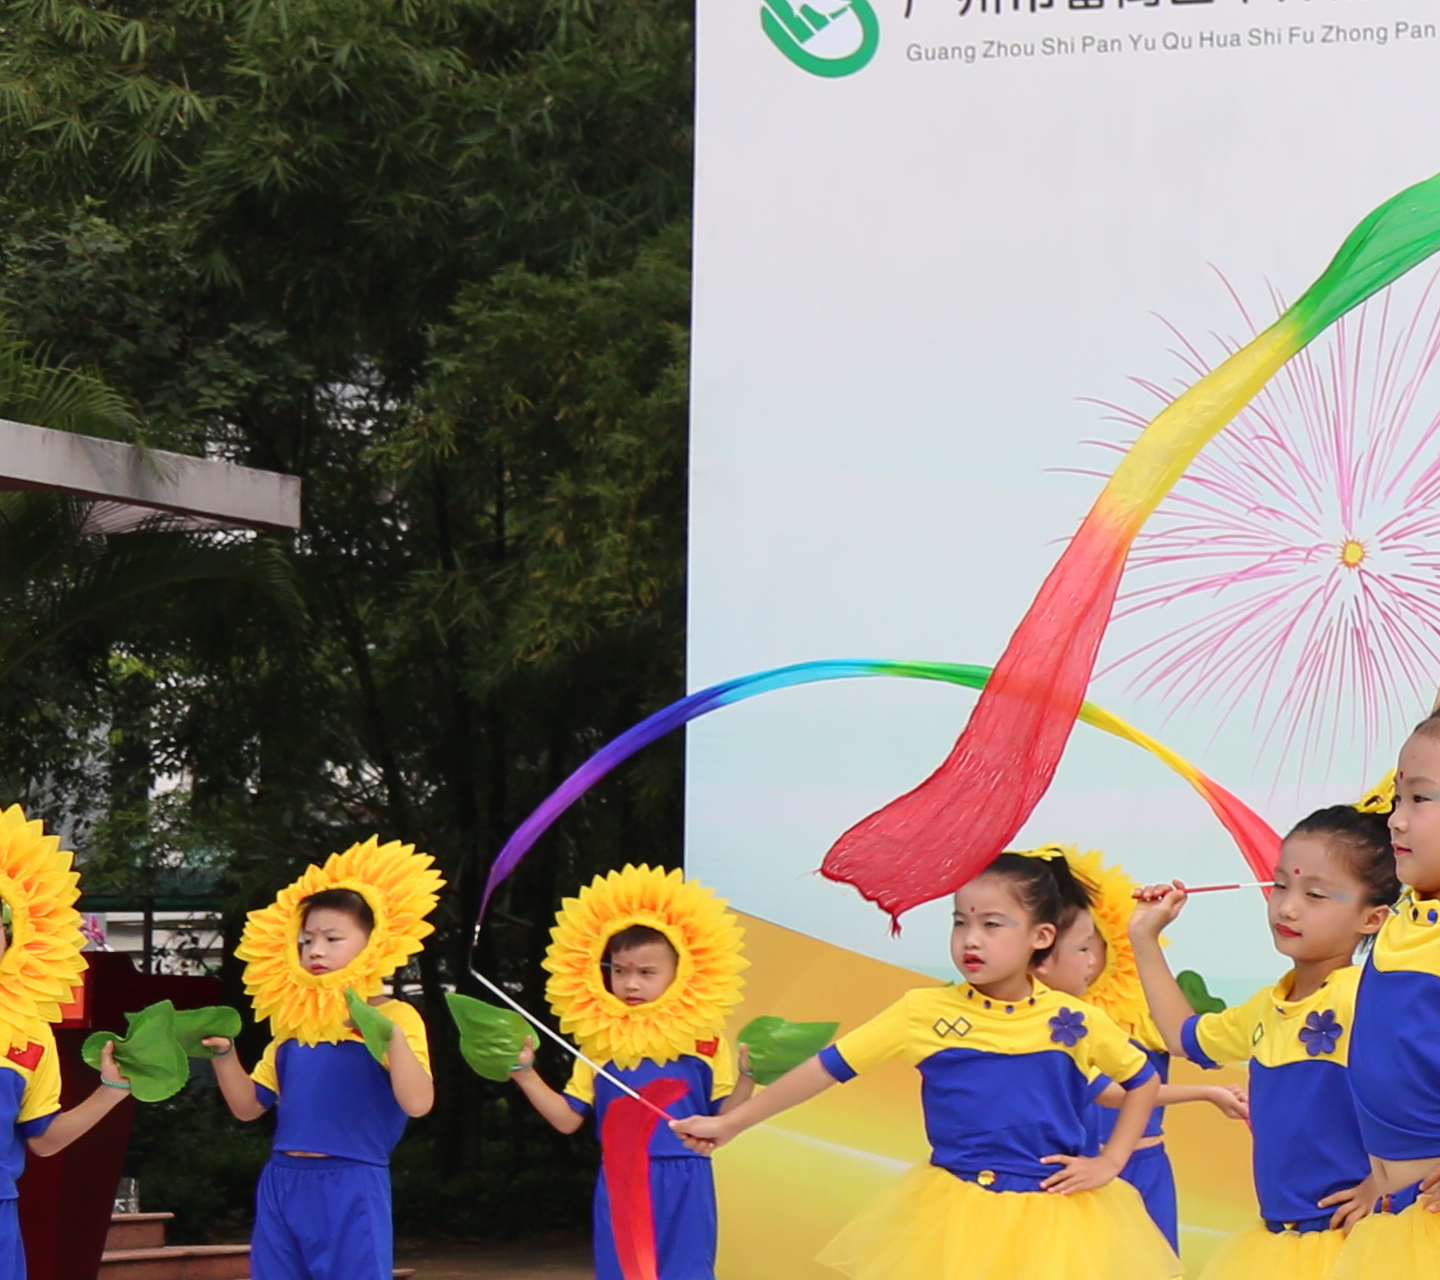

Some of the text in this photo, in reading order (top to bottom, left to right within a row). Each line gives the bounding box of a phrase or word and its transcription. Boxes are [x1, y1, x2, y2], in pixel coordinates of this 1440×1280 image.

[906, 43, 976, 64] Guang
[982, 40, 1035, 58] Zhou
[1041, 37, 1075, 55] Shi
[1081, 36, 1122, 53] Pan
[1128, 34, 1156, 51] Yu
[1162, 32, 1193, 50] Qu
[1199, 31, 1241, 48] Hua
[1248, 28, 1282, 46] Shi
[1289, 26, 1315, 44] Fu
[1321, 25, 1388, 45] Zhong
[1395, 22, 1436, 39] Pan
